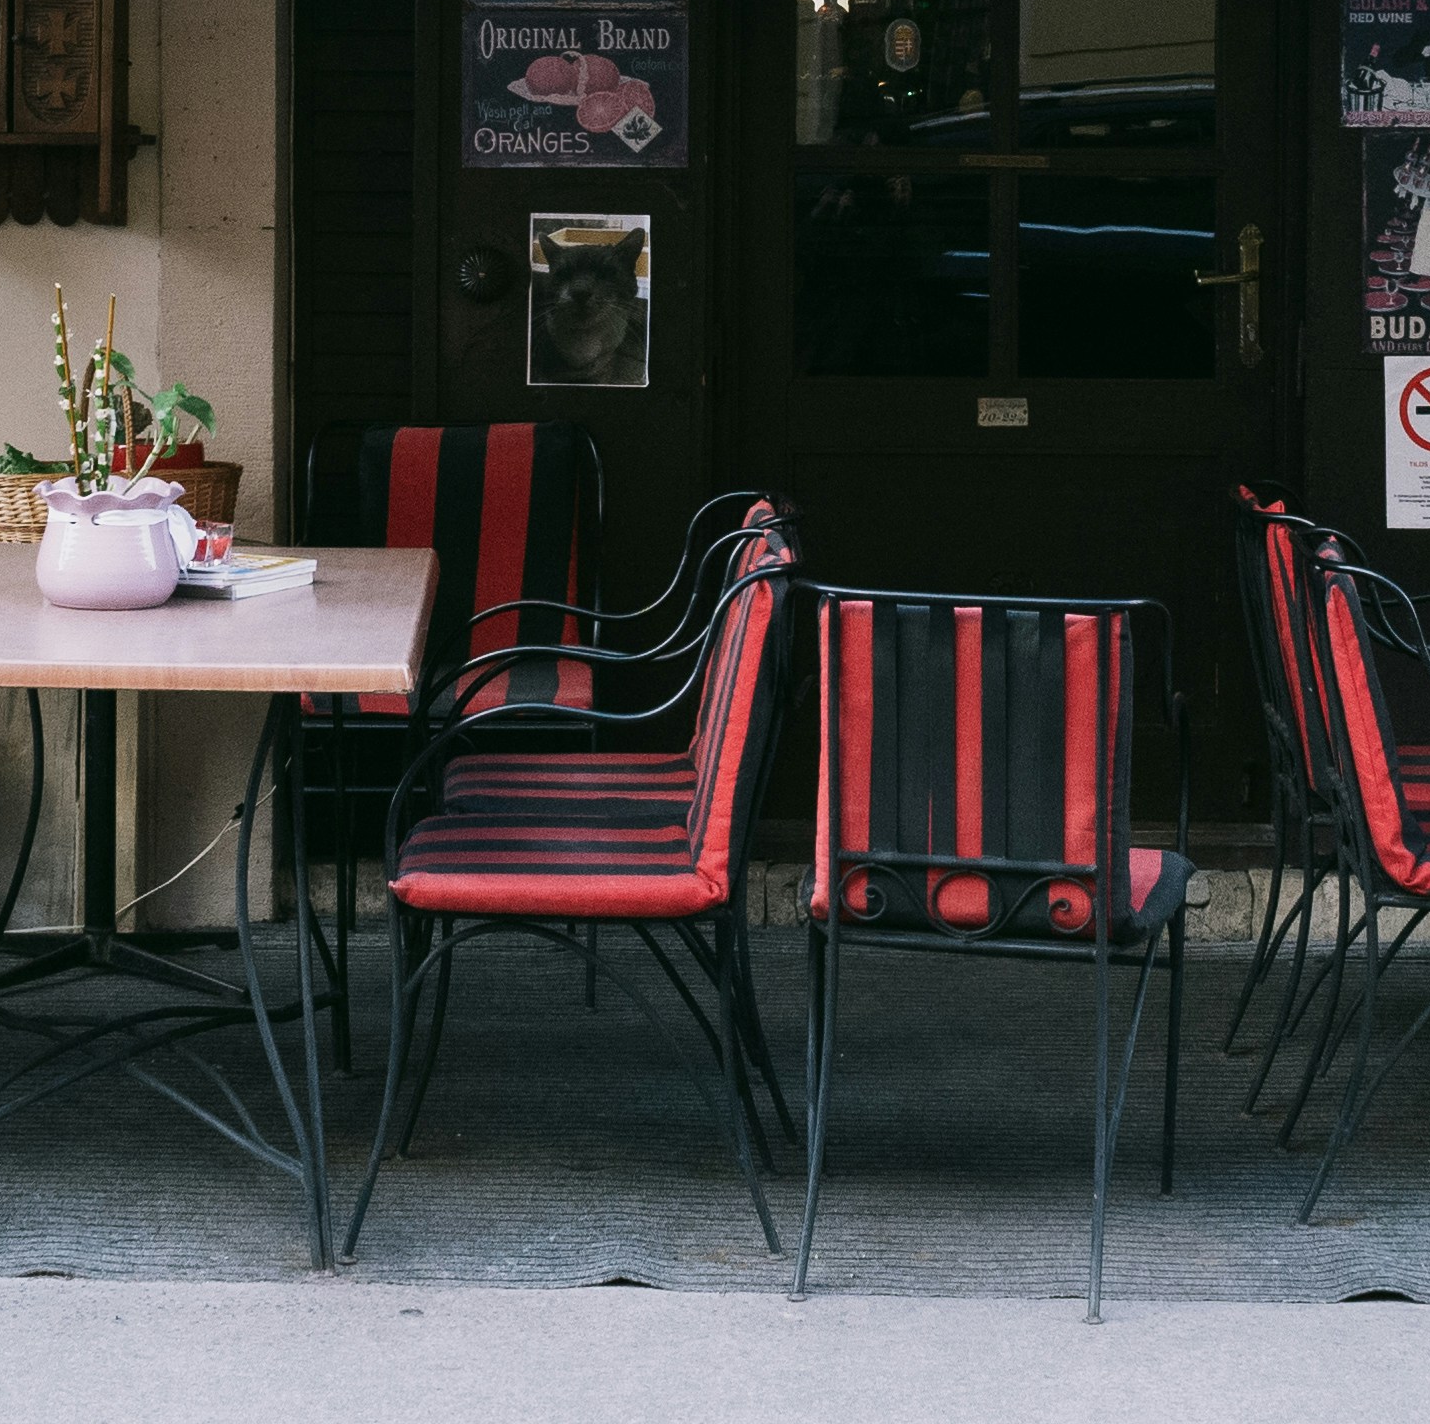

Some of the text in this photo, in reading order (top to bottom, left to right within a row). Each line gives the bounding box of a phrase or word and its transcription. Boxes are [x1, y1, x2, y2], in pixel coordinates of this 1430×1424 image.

[1348, 12, 1413, 24] RED WINE
[480, 19, 671, 59] ORIGINAL BRAND
[473, 127, 594, 154] ORANGES.
[1371, 341, 1395, 352] AND
[1397, 342, 1422, 352] EVERY
